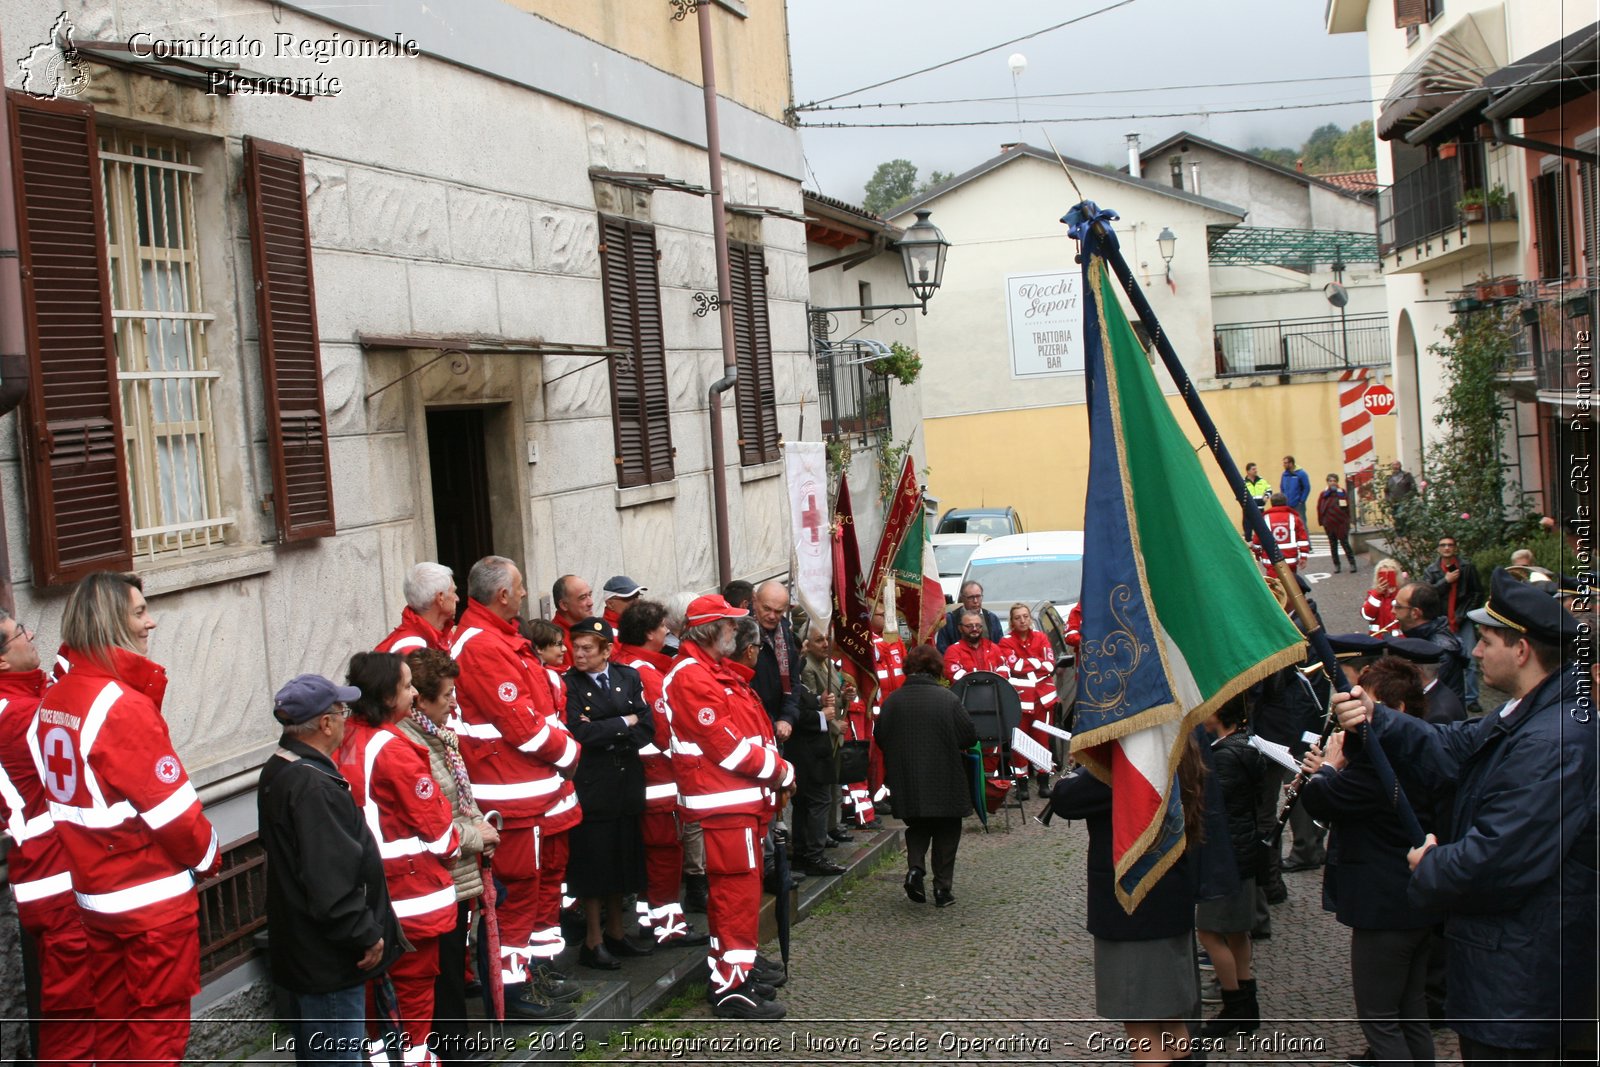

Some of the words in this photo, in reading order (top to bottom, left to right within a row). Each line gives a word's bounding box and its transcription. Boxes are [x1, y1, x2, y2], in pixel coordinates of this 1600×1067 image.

[1019, 279, 1073, 299] Vecchi
[1025, 294, 1077, 318] Sapori
[1032, 330, 1072, 344] TRATTORIA
[1038, 344, 1068, 356] PIZZERIA
[1047, 357, 1062, 368] BAR
[1365, 393, 1394, 407] STOP
